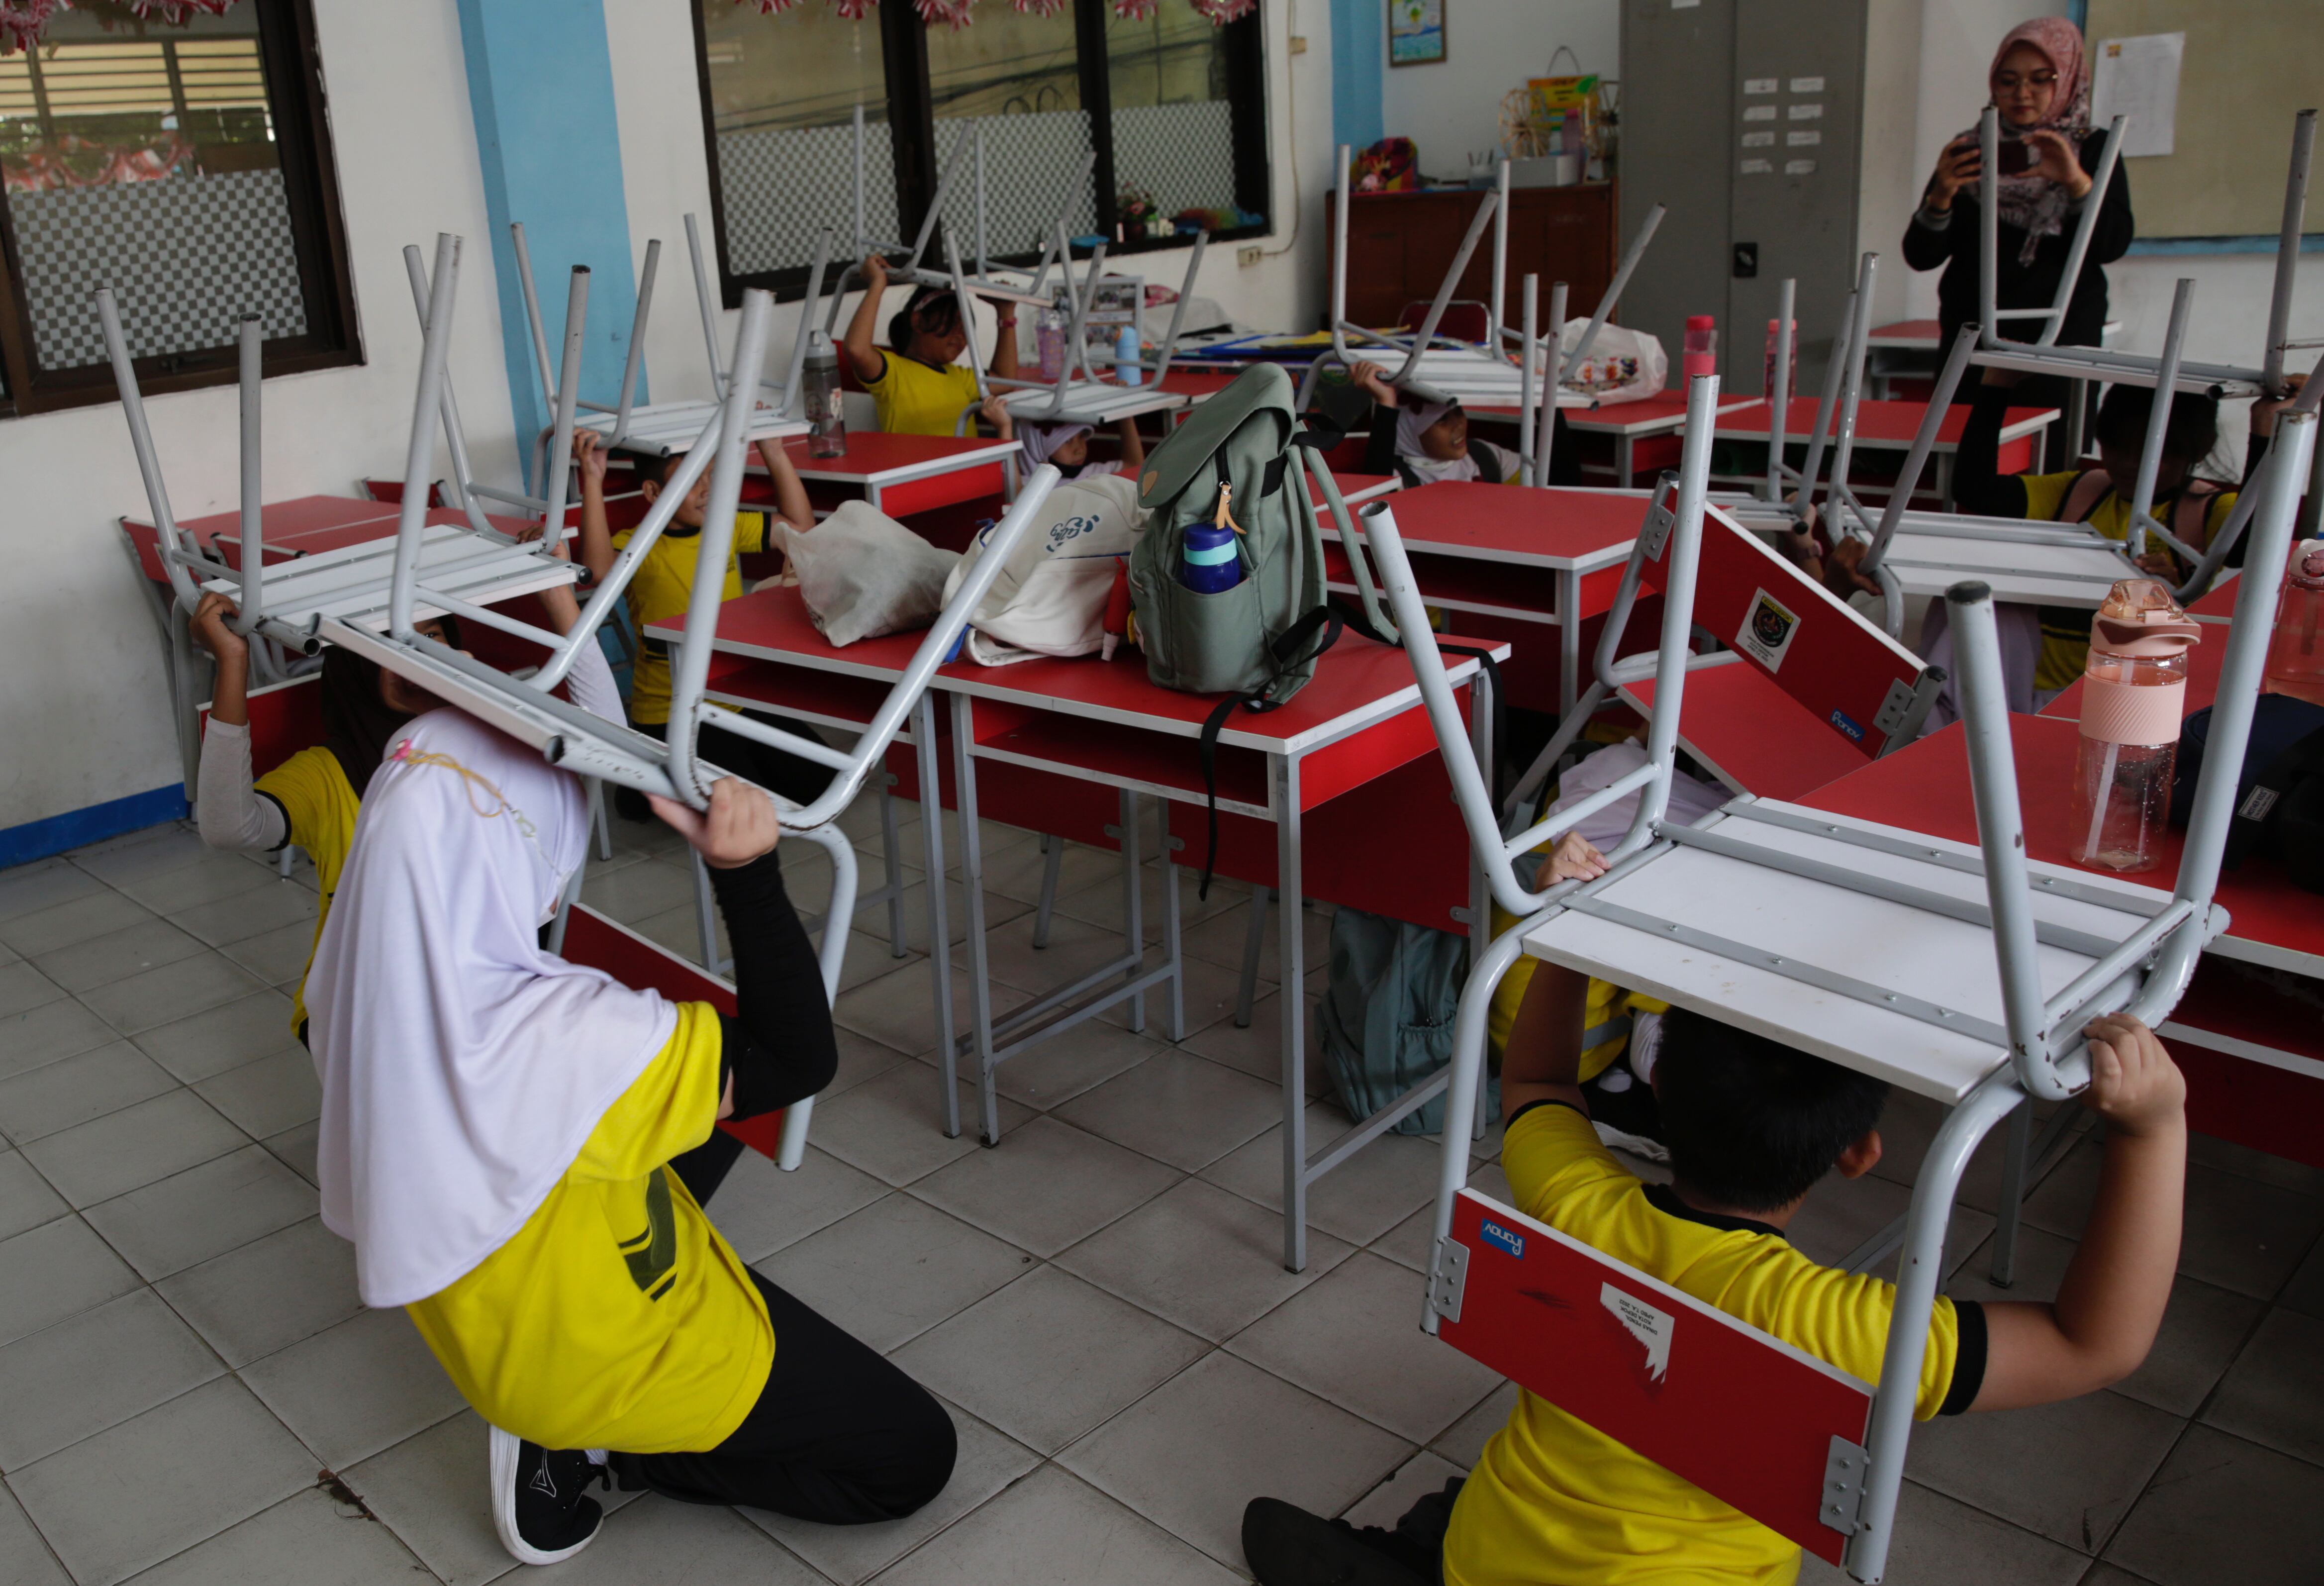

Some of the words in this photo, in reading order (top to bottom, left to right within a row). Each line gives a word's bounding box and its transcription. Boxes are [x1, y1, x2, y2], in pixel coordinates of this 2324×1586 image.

[1619, 1298, 1630, 1308] 2022
[1620, 1305, 1638, 1318] DEPOK
[1640, 1310, 1654, 1320] APBD
[1638, 1314, 1651, 1325] KOTA
[1643, 1323, 1658, 1335] DINAS
